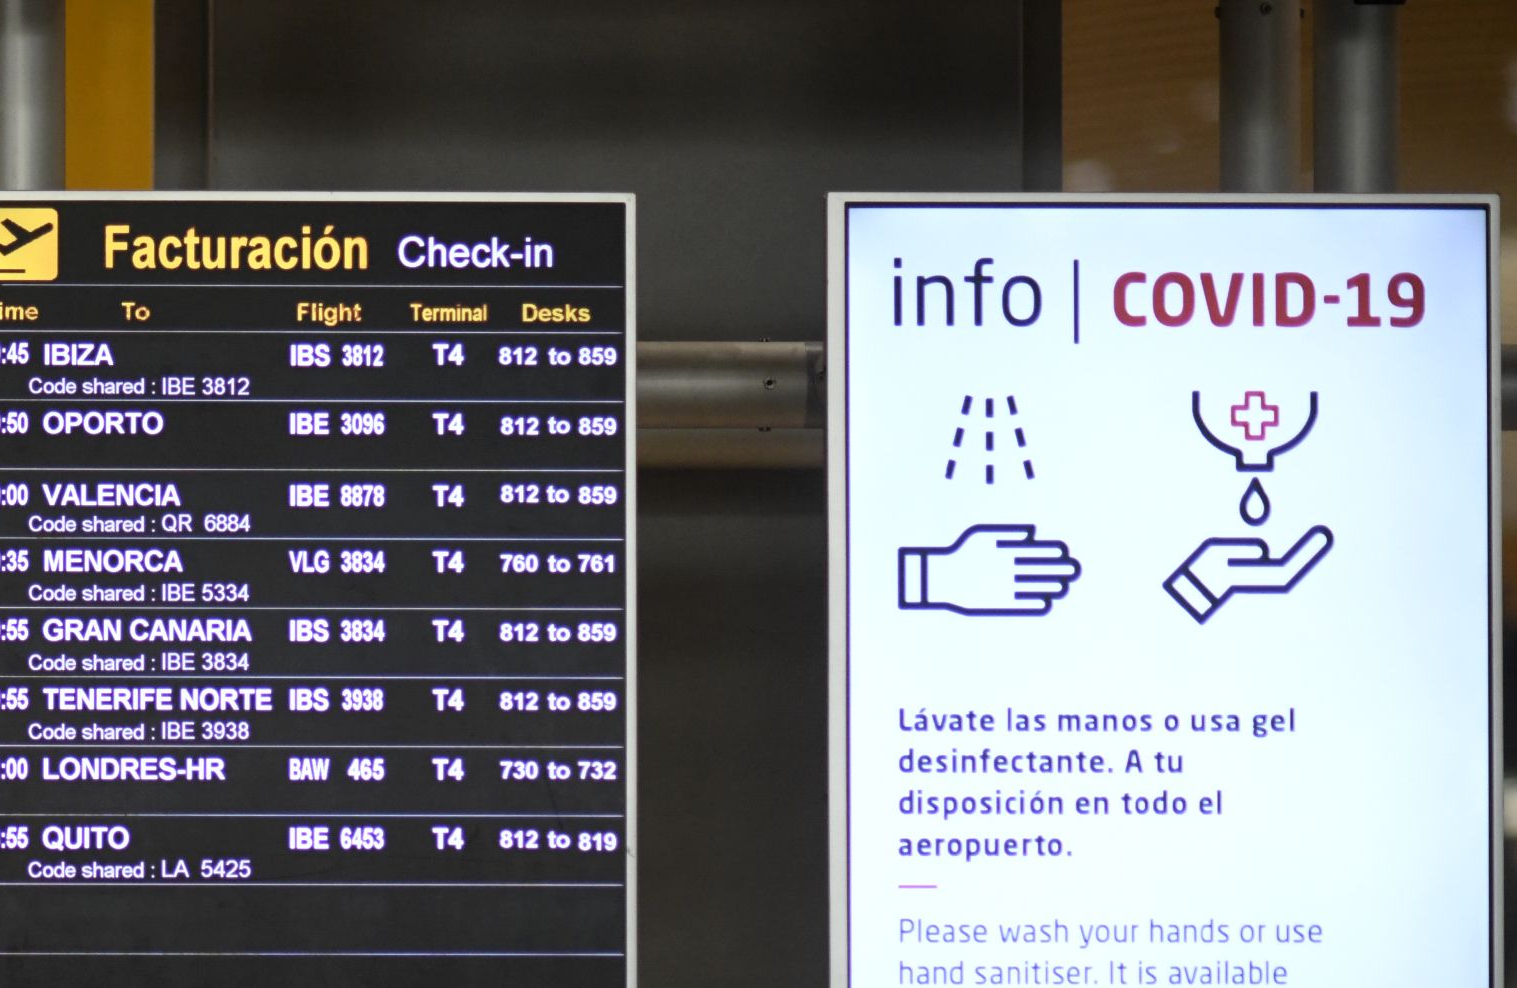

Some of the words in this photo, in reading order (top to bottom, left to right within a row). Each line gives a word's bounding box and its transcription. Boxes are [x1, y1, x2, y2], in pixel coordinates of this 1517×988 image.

[105, 225, 367, 269] Facturación
[398, 236, 552, 268] Check-in
[893, 257, 1042, 327] info
[1113, 271, 1426, 328] COVID-19
[122, 302, 150, 320] To
[297, 303, 361, 326] Flight
[410, 304, 487, 321] Terminal
[522, 304, 590, 322] Desks
[44, 344, 113, 365] IBIZA
[290, 344, 331, 367] IBS
[342, 344, 383, 366] 3812
[432, 343, 464, 365] T4
[499, 347, 537, 365] 812
[548, 348, 571, 365] to
[578, 347, 617, 365] 859
[29, 377, 77, 394] Code
[82, 378, 144, 394] shared
[163, 377, 195, 395] IBE
[202, 377, 249, 395] 3812
[44, 549, 183, 572] MENORCA
[289, 550, 329, 573] VLG
[341, 551, 385, 573] 3834
[432, 551, 464, 573] T4
[500, 554, 538, 572] 760
[547, 555, 571, 573] to
[578, 554, 614, 573] 761
[899, 708, 994, 731] Lávate
[1008, 707, 1046, 731] las
[1058, 714, 1152, 732] manos
[1165, 714, 1179, 732] o
[1191, 715, 1240, 732] usa
[1253, 708, 1295, 738] gel
[43, 757, 225, 781] LONDRES-HR
[289, 758, 330, 780] BAW
[347, 758, 384, 780] 465
[432, 758, 464, 781] T4
[500, 761, 539, 779] 730
[547, 762, 571, 780] to
[578, 761, 616, 780] 732
[899, 748, 1113, 773] desinfectante.
[1125, 749, 1143, 773] A
[1154, 752, 1182, 773] tu
[899, 790, 1063, 820] disposición
[1076, 797, 1109, 814] en
[1121, 790, 1187, 815] todo
[1199, 790, 1222, 815] el
[42, 826, 129, 851] QUITO
[289, 827, 329, 849] IBE
[340, 827, 384, 849] 6453
[432, 827, 464, 849] T4
[500, 830, 538, 849] 812
[547, 831, 571, 848] to
[578, 832, 617, 851] 819
[899, 836, 1071, 862] aeropuerto.
[900, 919, 987, 943] Please
[999, 919, 1068, 943] wash
[1080, 925, 1138, 949] your
[1150, 919, 1229, 943] hands
[1240, 924, 1266, 943] or
[1276, 924, 1323, 943] use
[900, 961, 963, 985] hand
[975, 961, 1097, 985] sanitiser.
[1110, 961, 1127, 984] It
[1139, 960, 1157, 985] is
[1169, 960, 1287, 985] available
